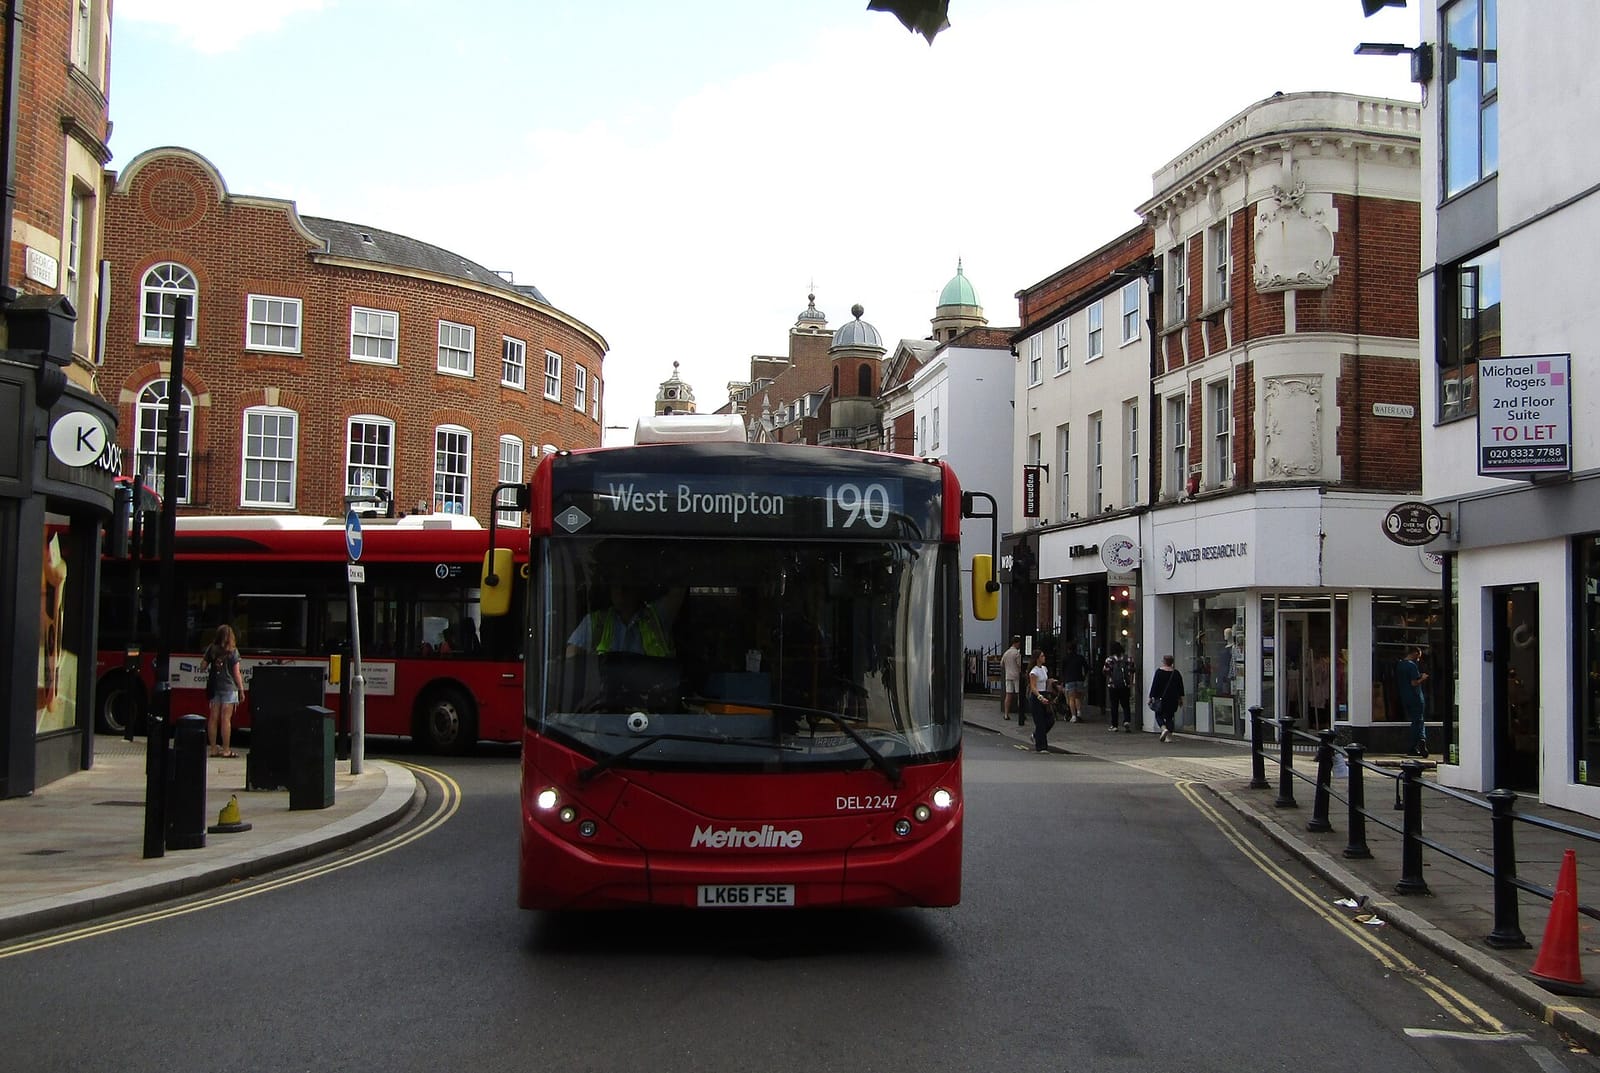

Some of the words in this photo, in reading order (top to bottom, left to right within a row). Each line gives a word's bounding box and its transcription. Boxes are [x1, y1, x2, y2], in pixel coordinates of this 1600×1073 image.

[31, 252, 54, 271] GEORGE
[33, 266, 51, 282] STREET
[1482, 364, 1533, 377] Michael
[1506, 377, 1546, 390] Rogers
[1493, 397, 1517, 408] 2nd
[1521, 396, 1555, 407] Floor
[1375, 405, 1395, 415] WATER
[1396, 406, 1413, 416] LANE
[1507, 410, 1540, 420] Suite
[77, 426, 97, 452] K
[1492, 426, 1518, 441] TO
[1524, 425, 1557, 440] LET
[1487, 457, 1564, 465] www.michaelrogers.co.uk
[1490, 450, 1508, 458] 020
[1510, 449, 1534, 458] 8332
[1537, 448, 1561, 456] 7788
[1026, 473, 1034, 513] wagamama
[609, 483, 668, 512] West
[677, 484, 785, 523] Brompton
[825, 482, 890, 529] 190
[1176, 548, 1201, 563] CANCER
[1201, 544, 1236, 560] RESEARCH
[1237, 542, 1248, 556] UK
[836, 795, 898, 811] DEL2247
[690, 825, 803, 849] Metroline
[704, 887, 749, 904] LK66
[754, 887, 788, 904] FSE
